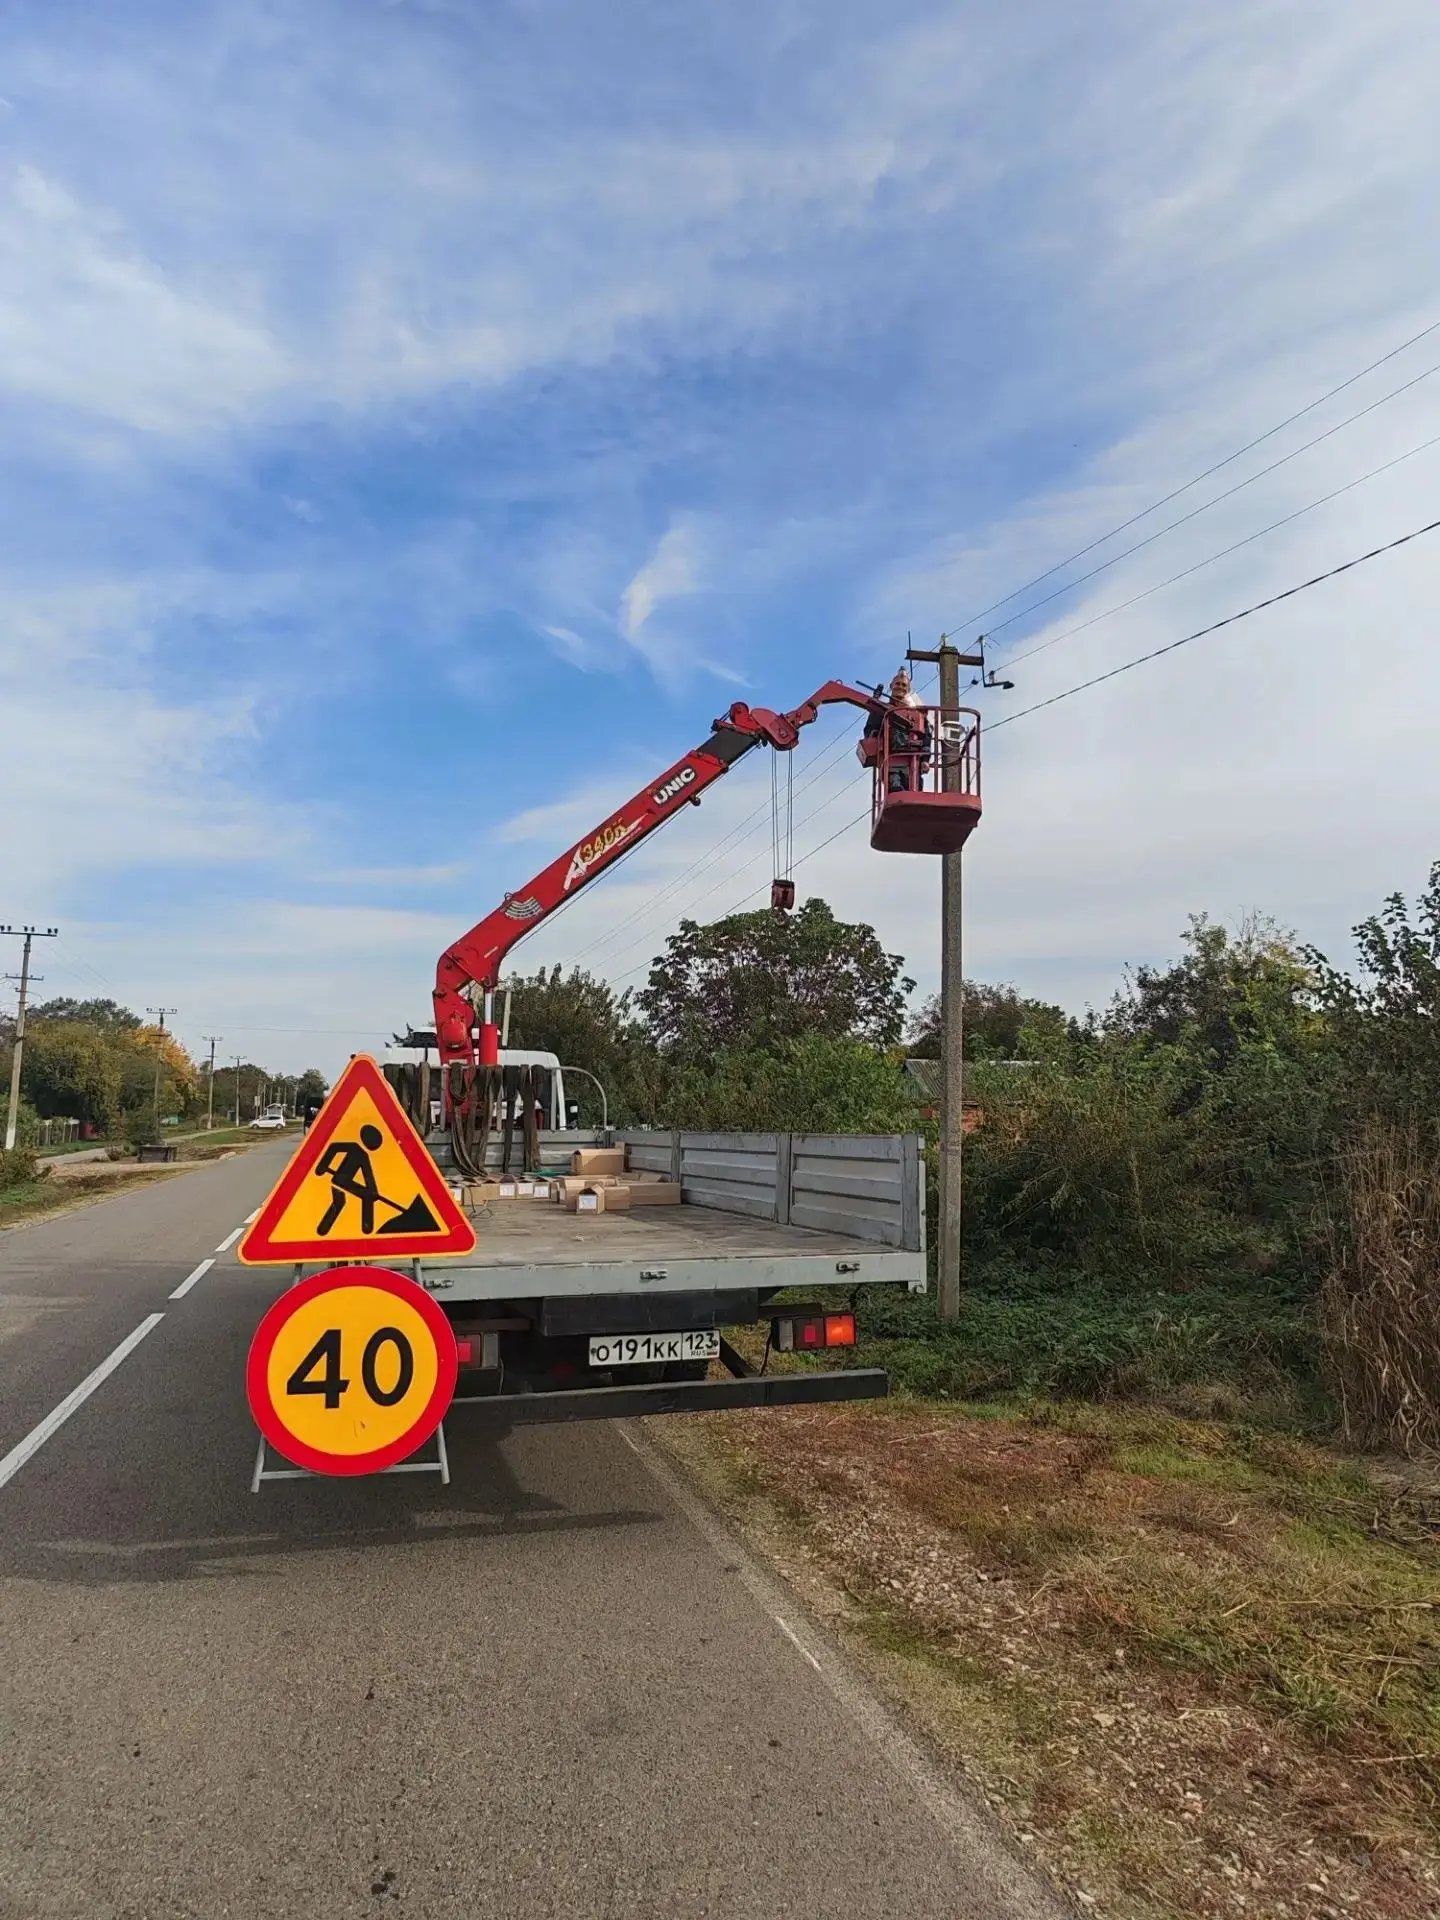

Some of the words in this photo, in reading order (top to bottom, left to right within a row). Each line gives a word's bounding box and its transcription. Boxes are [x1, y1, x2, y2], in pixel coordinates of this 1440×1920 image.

[653, 768, 696, 805] UNIC
[685, 1332, 715, 1350] 123
[286, 1326, 414, 1410] 40
